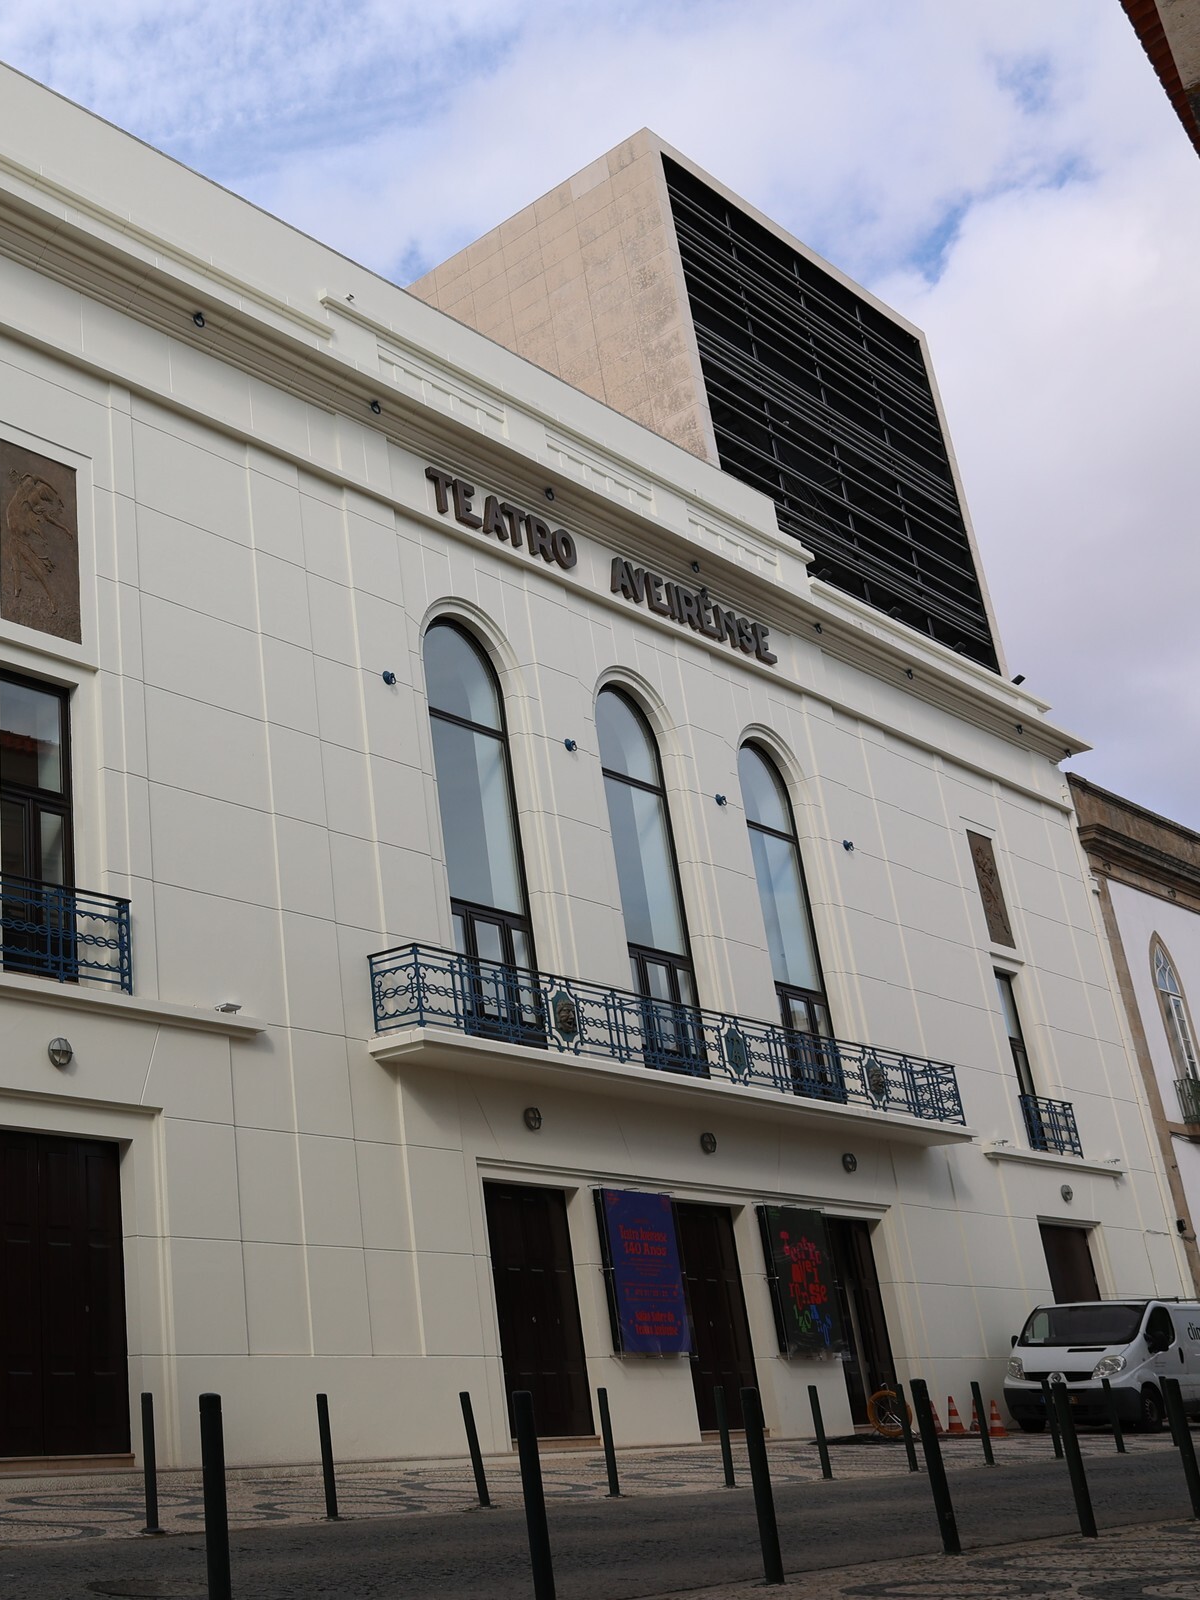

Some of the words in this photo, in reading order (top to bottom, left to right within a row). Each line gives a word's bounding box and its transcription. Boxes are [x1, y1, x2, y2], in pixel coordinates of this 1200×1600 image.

[424, 466, 578, 570] TEATRO
[624, 1241, 642, 1255] 140
[644, 1242, 667, 1256] Anos
